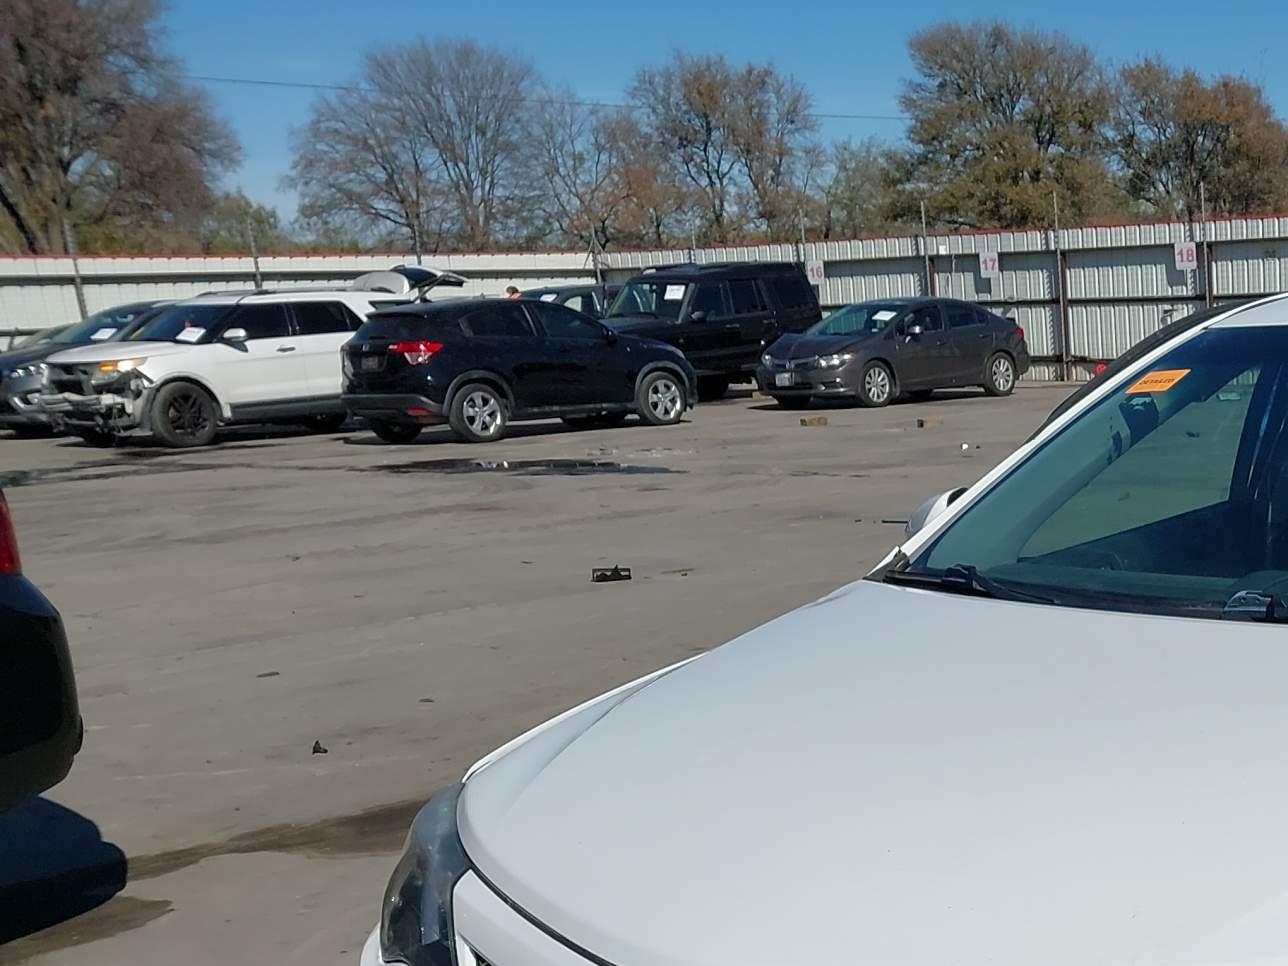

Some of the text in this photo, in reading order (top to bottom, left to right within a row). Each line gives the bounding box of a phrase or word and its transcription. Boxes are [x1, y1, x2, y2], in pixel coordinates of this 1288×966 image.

[1177, 248, 1195, 263] 18
[982, 257, 997, 271] 17
[810, 265, 823, 279] 16
